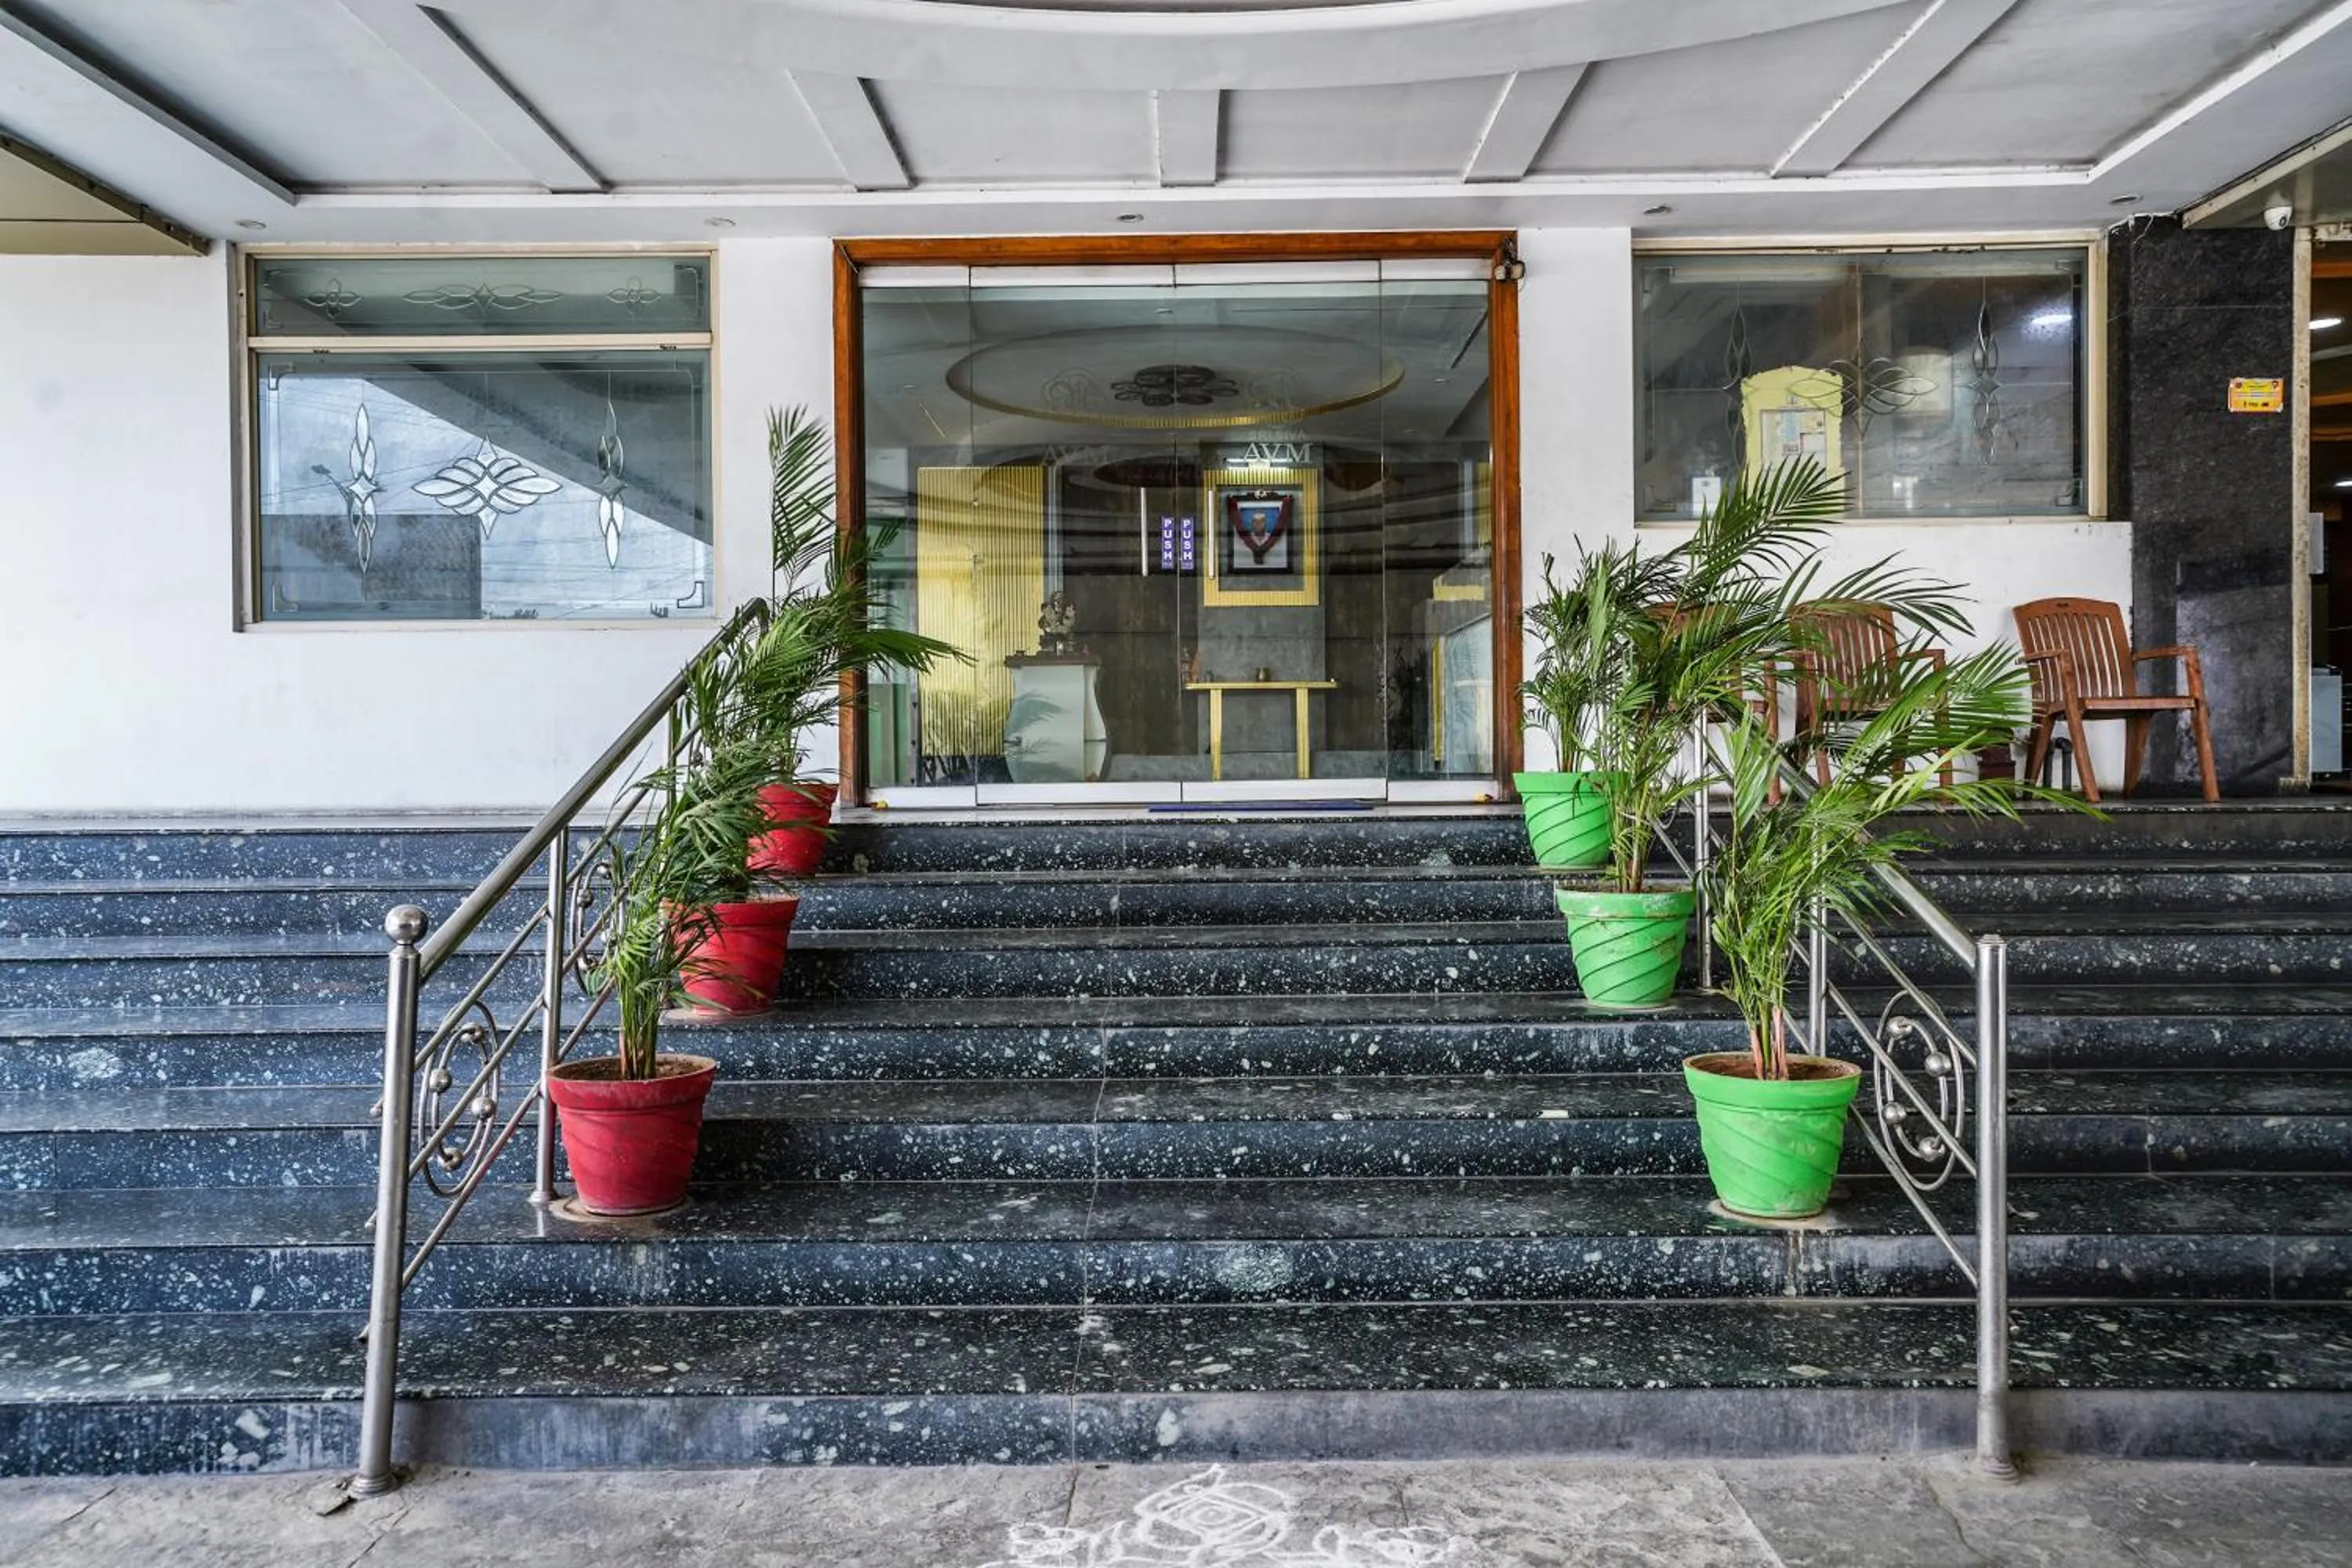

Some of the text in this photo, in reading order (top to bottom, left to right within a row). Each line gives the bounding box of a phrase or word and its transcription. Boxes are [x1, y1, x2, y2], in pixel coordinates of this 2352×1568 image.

[1243, 442, 1314, 464] AVM
[1164, 518, 1173, 561] PUSH
[1183, 519, 1192, 561] PUSH
